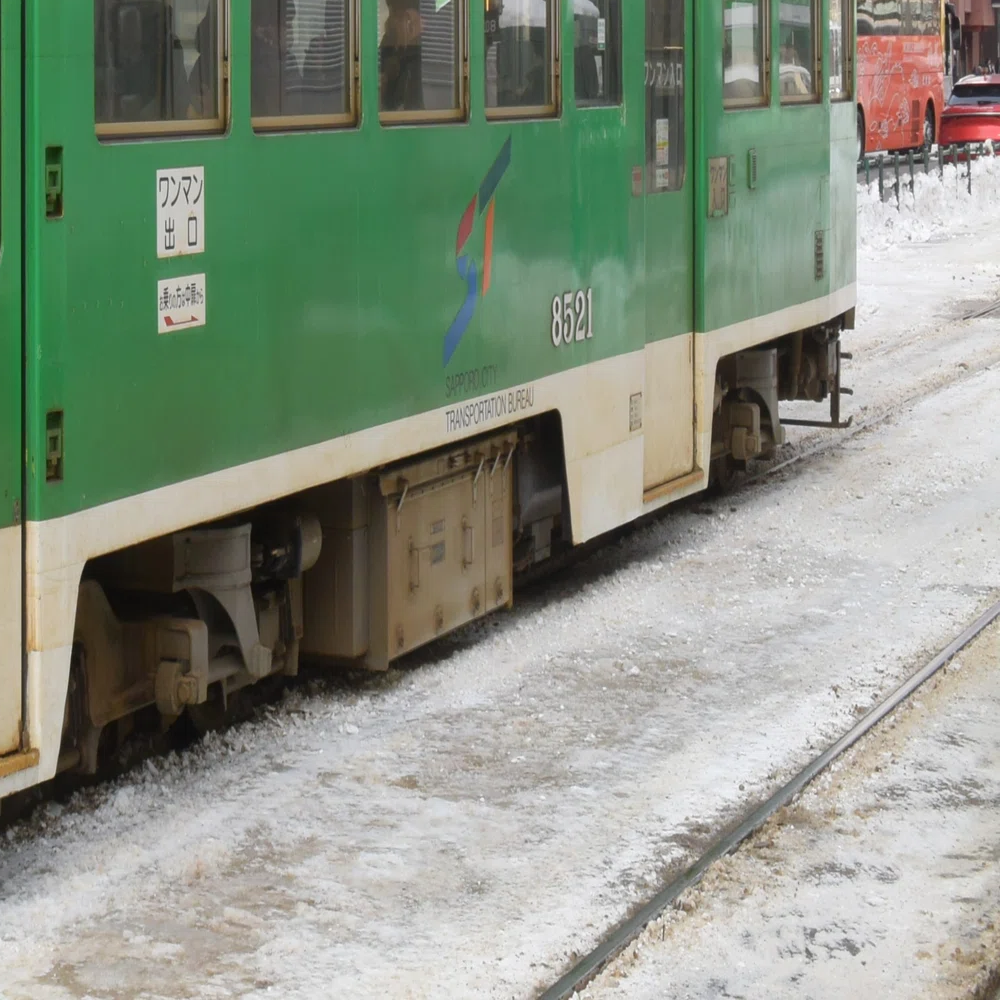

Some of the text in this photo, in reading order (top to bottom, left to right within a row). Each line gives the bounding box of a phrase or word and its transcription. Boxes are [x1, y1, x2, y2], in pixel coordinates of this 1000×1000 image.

[159, 174, 203, 208] ワンマン
[165, 216, 198, 250] 出口
[552, 288, 593, 347] 8521
[446, 364, 498, 398] SAPPORO CITY
[446, 386, 534, 433] TRANSPORTATION BUREAU
